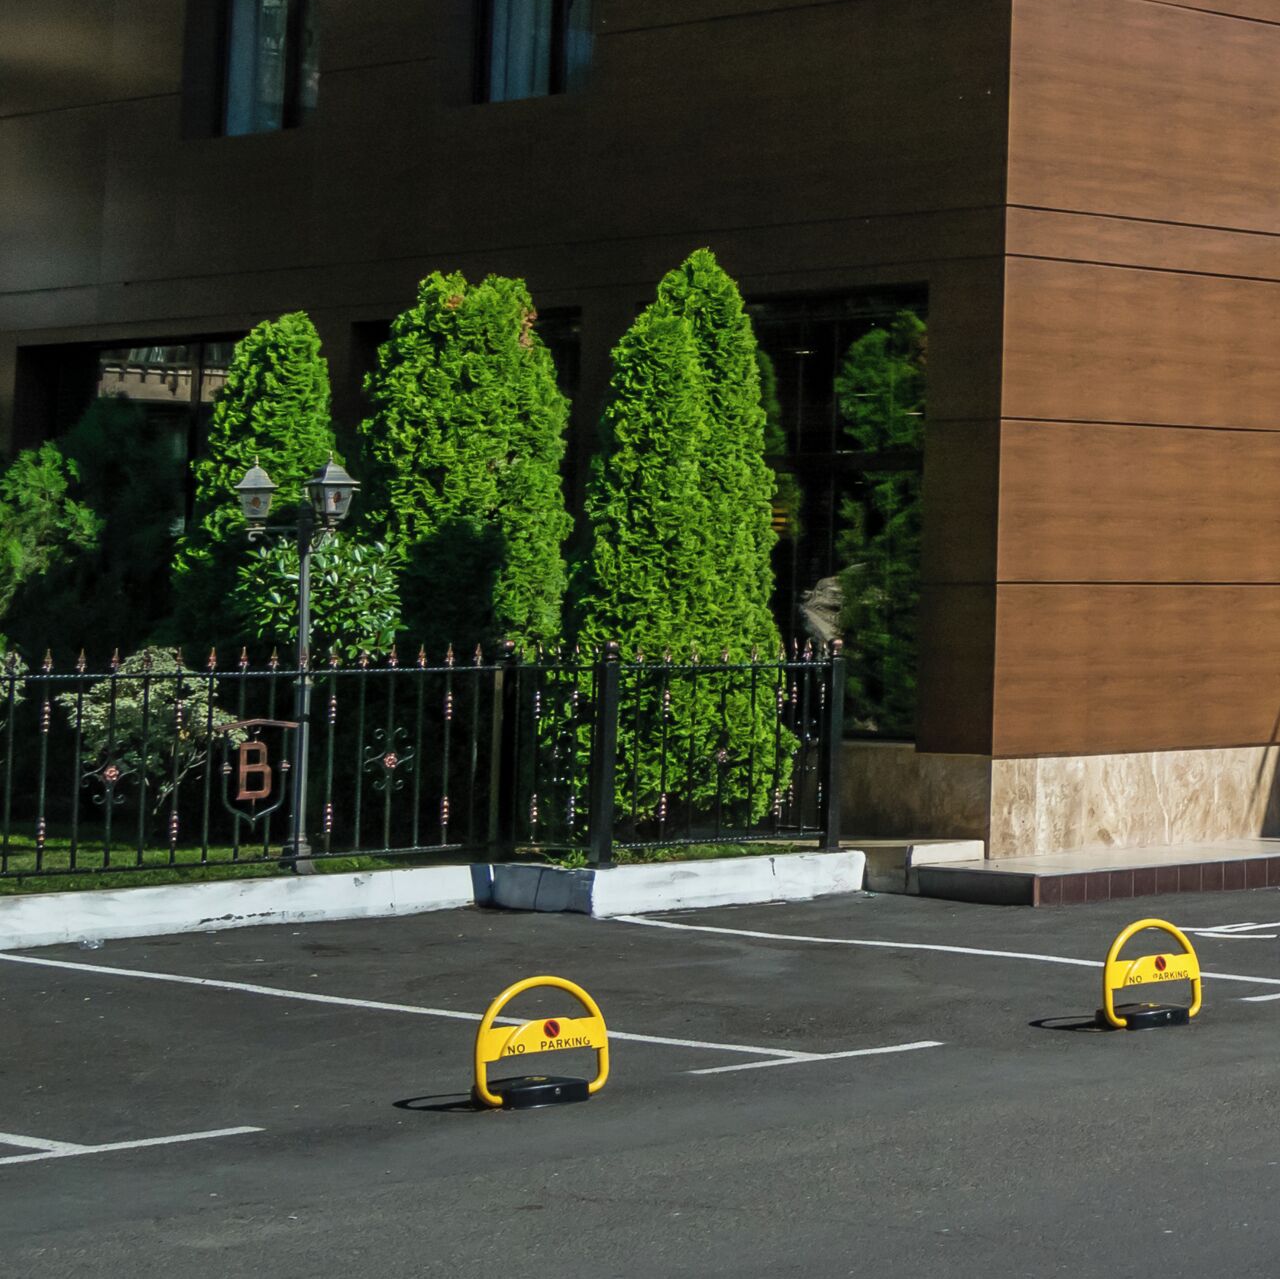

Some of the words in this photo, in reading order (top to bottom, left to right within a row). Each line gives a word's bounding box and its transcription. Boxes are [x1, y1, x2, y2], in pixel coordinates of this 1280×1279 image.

[236, 741, 272, 800] B
[1129, 975, 1142, 984] NO
[1153, 970, 1188, 980] PARKING
[507, 1044, 525, 1054] NO
[540, 1036, 590, 1050] PARKING
